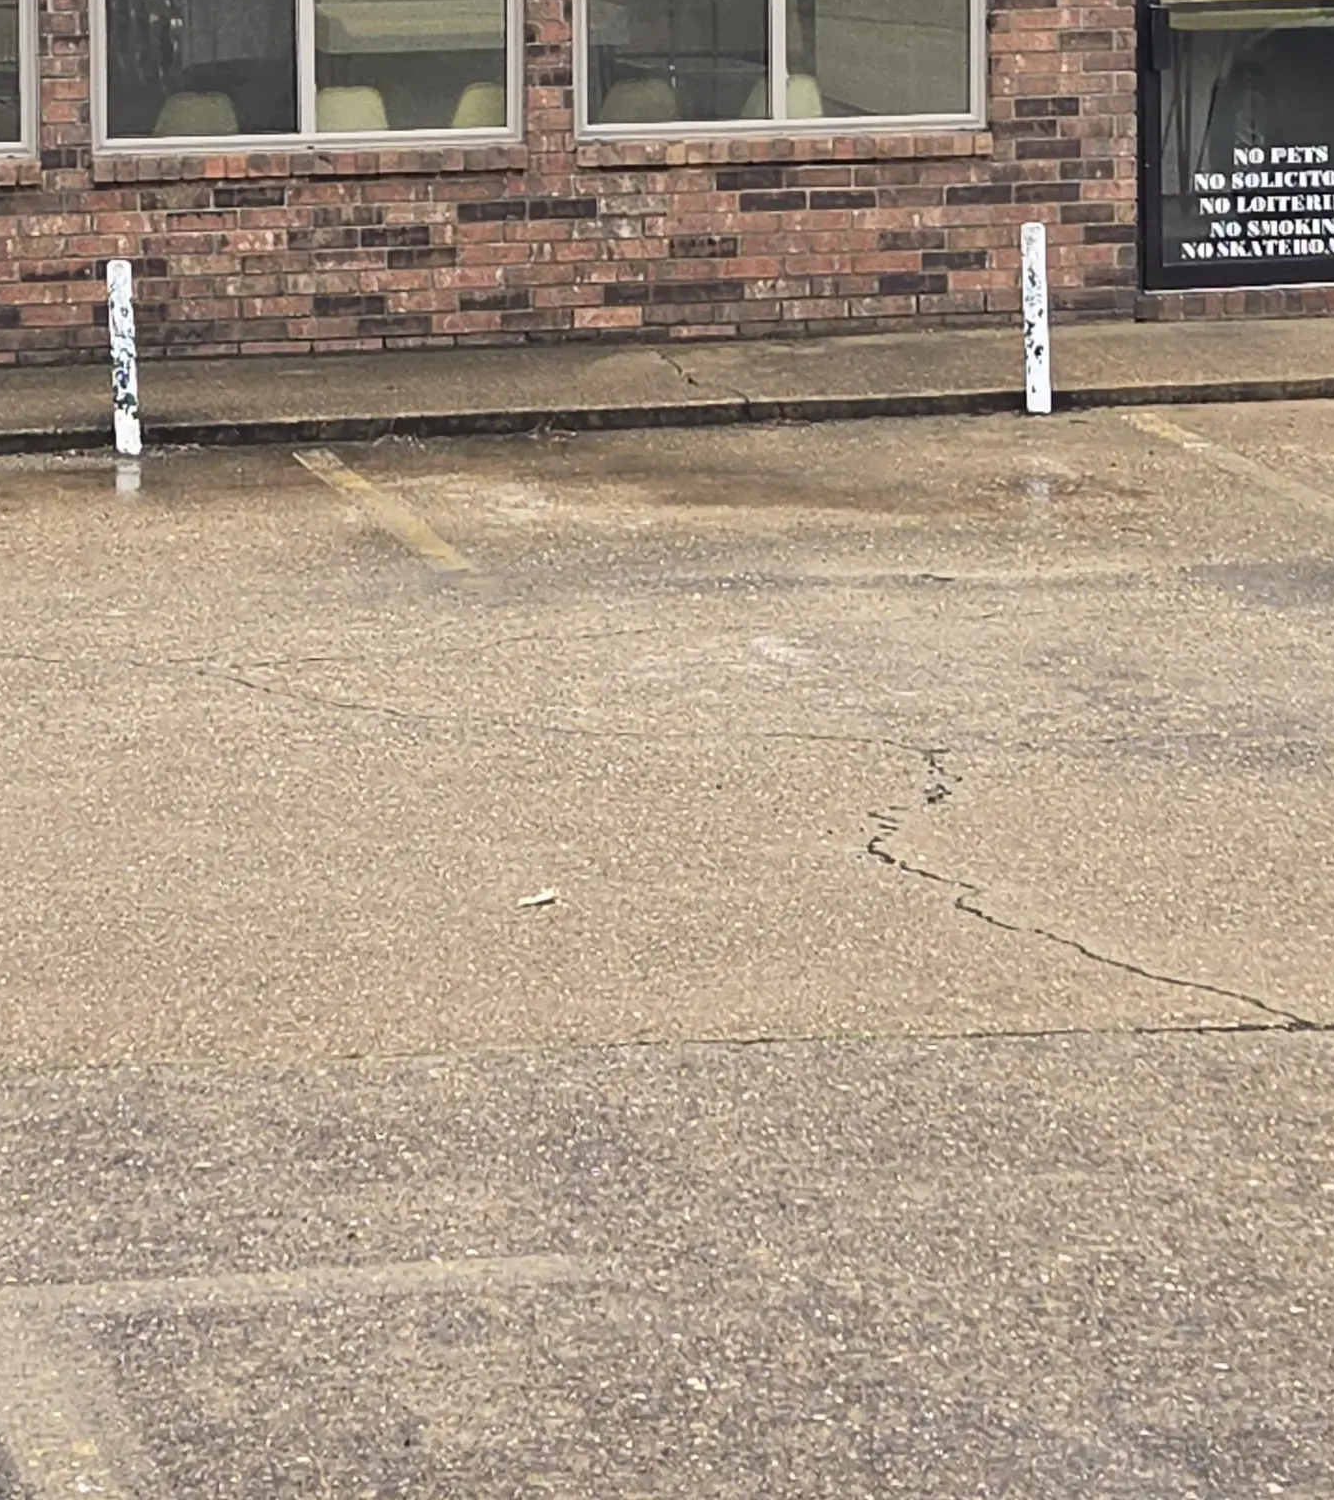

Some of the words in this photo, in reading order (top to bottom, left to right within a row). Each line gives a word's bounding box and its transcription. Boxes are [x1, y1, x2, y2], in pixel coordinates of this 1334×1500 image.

[1233, 147, 1265, 165] NO
[1271, 145, 1329, 164] PETS
[1194, 172, 1226, 191] NO
[1199, 197, 1231, 215] NO
[1209, 221, 1242, 238] NO
[1181, 241, 1214, 259] NO
